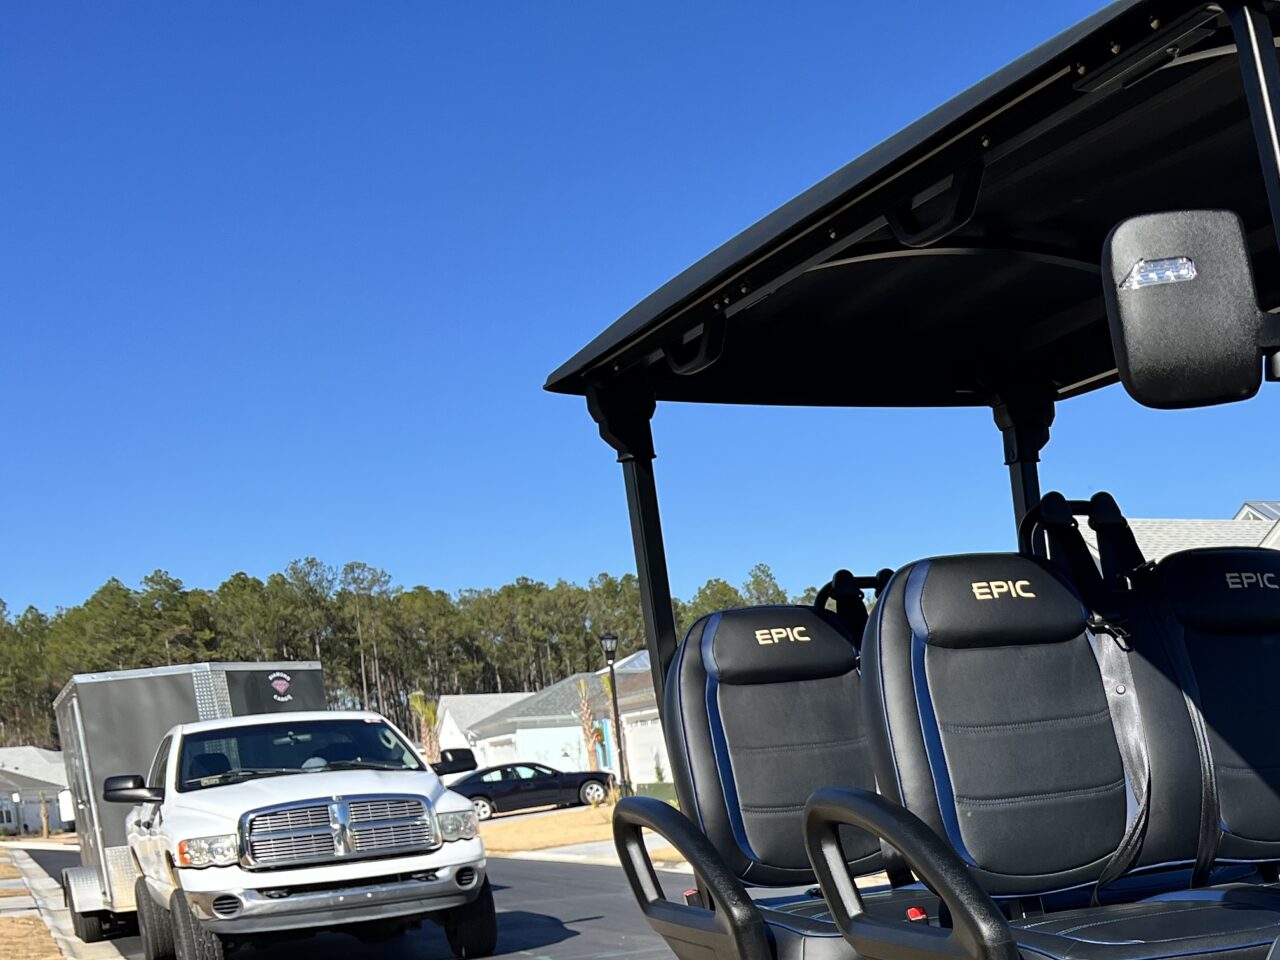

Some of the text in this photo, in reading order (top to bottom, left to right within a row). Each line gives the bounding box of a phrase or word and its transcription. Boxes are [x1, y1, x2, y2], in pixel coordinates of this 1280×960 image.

[971, 580, 1036, 600] EPIC
[1225, 572, 1280, 589] EPIC
[754, 626, 812, 645] EPIC
